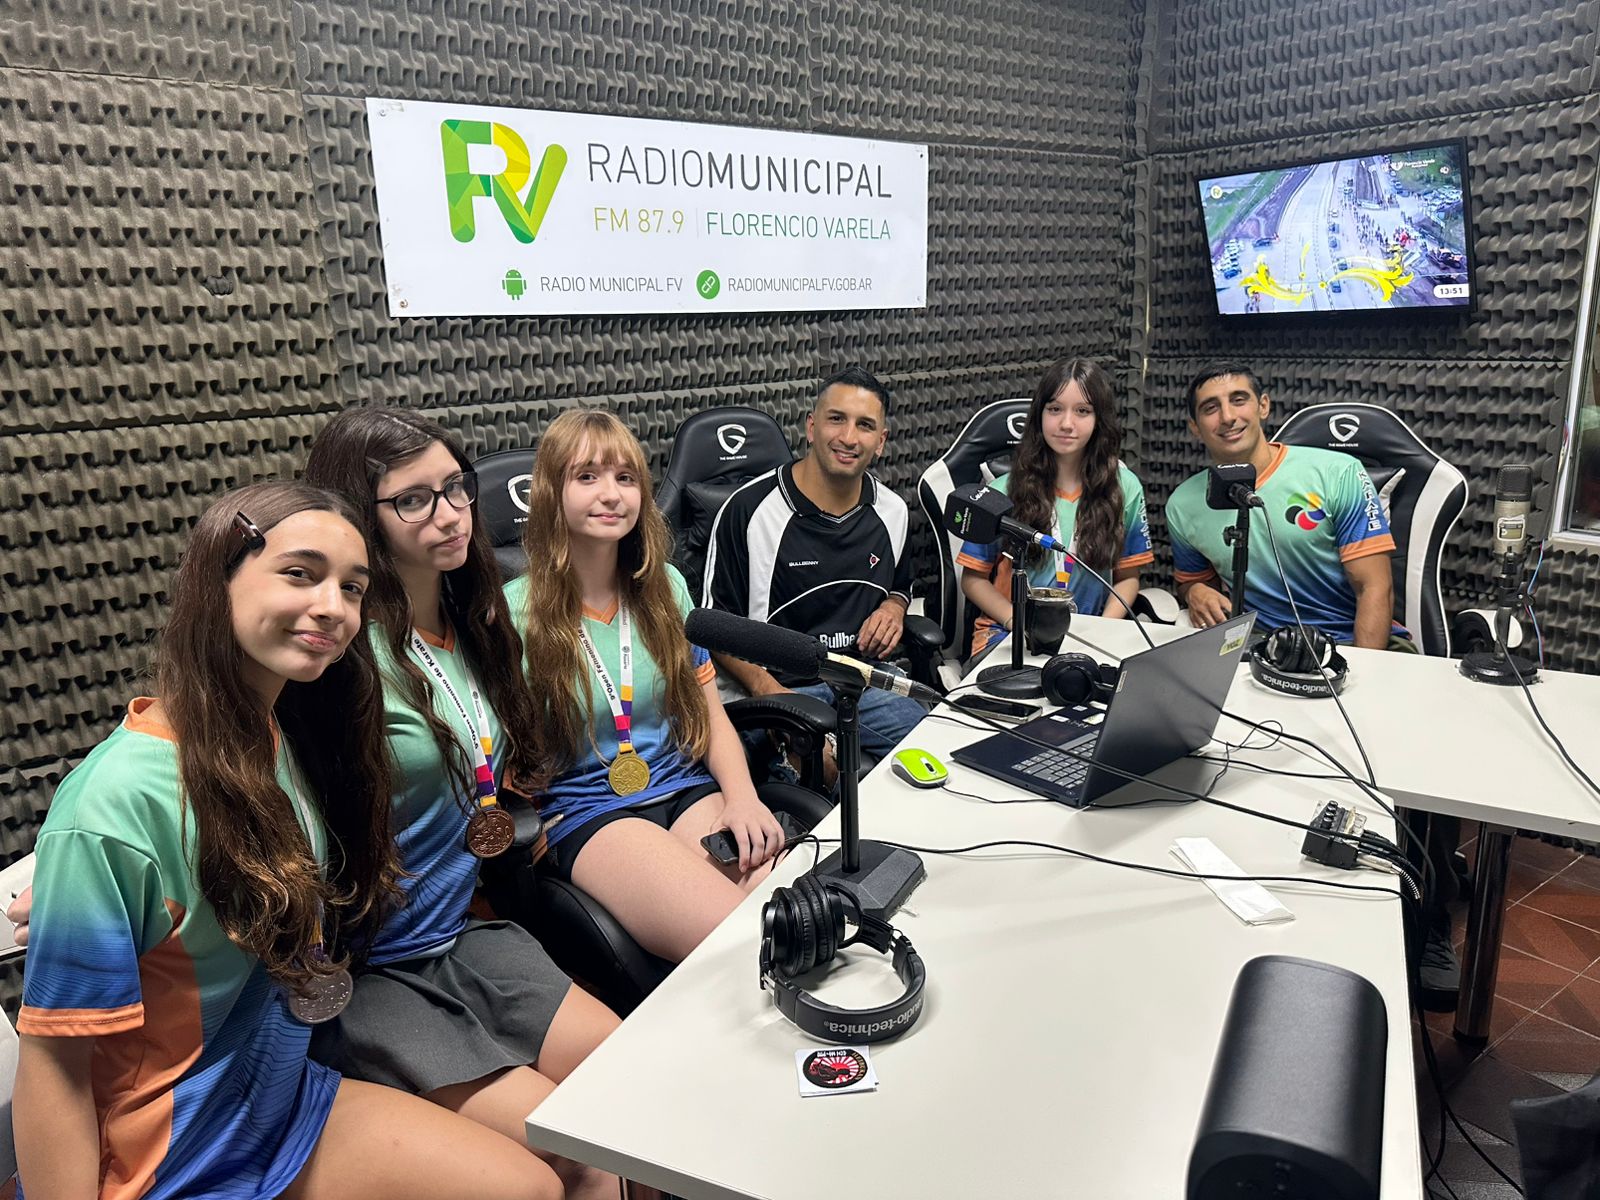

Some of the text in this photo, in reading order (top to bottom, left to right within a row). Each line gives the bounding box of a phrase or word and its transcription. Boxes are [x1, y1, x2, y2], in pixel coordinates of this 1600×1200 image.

[587, 142, 892, 199] RADIOMUNICIPAL
[594, 207, 891, 240] FM 87.9 FLORENCIO VARELA
[540, 276, 683, 292] RADIO MUNICIPAL FV
[728, 277, 873, 292] RADIOMUNICIPALFV.GOB.AR
[1440, 287, 1463, 295] 13:51
[1357, 470, 1382, 532] KARATE
[414, 638, 435, 667] Karate
[819, 632, 856, 649] Bullbe
[583, 639, 603, 674] Femenino
[433, 667, 443, 678] de
[442, 679, 467, 718] Femenino
